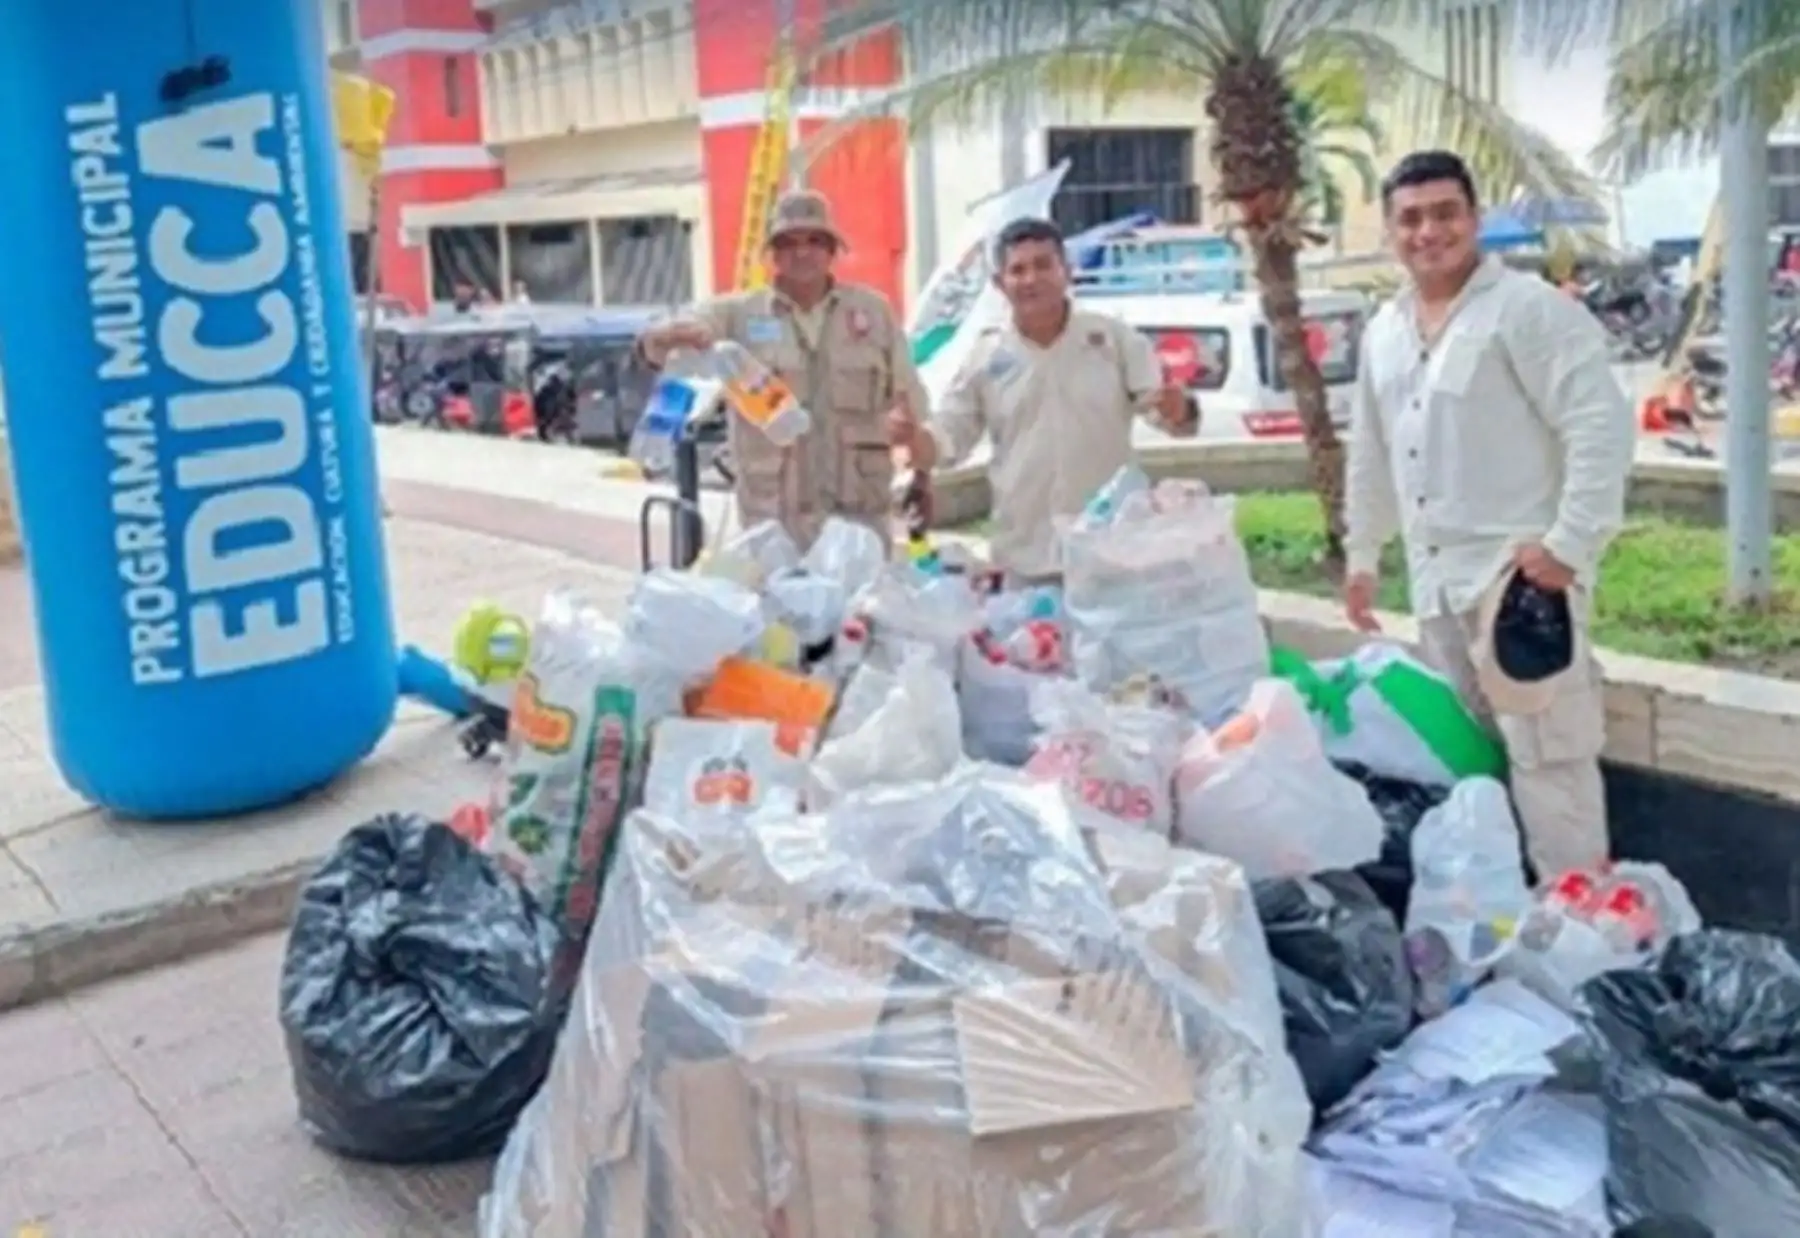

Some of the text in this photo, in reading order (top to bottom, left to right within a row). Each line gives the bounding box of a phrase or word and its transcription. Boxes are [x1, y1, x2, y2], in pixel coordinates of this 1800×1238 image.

[66, 91, 183, 685] PROGRAMA MUNICIPAL
[136, 91, 330, 678] EDUCCA
[312, 384, 331, 398] Y
